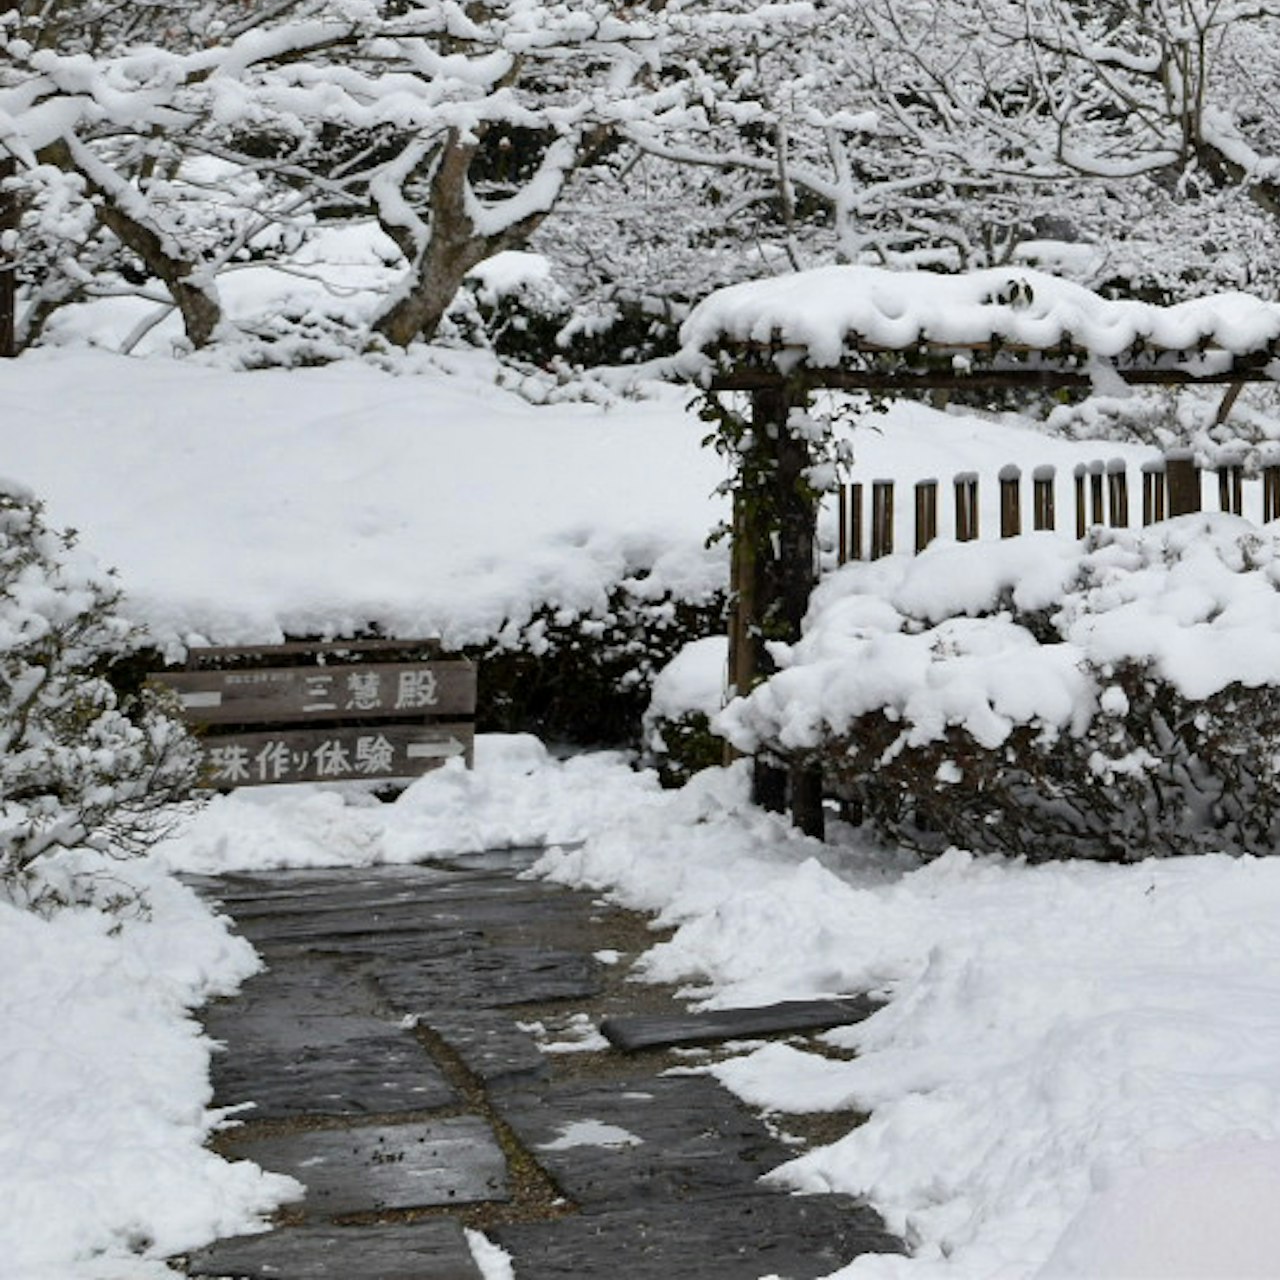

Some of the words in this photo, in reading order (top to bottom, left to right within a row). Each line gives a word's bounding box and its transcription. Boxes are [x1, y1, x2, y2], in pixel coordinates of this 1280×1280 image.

[303, 670, 438, 712] 三慧殿
[196, 735, 395, 782] 珠作り体験
